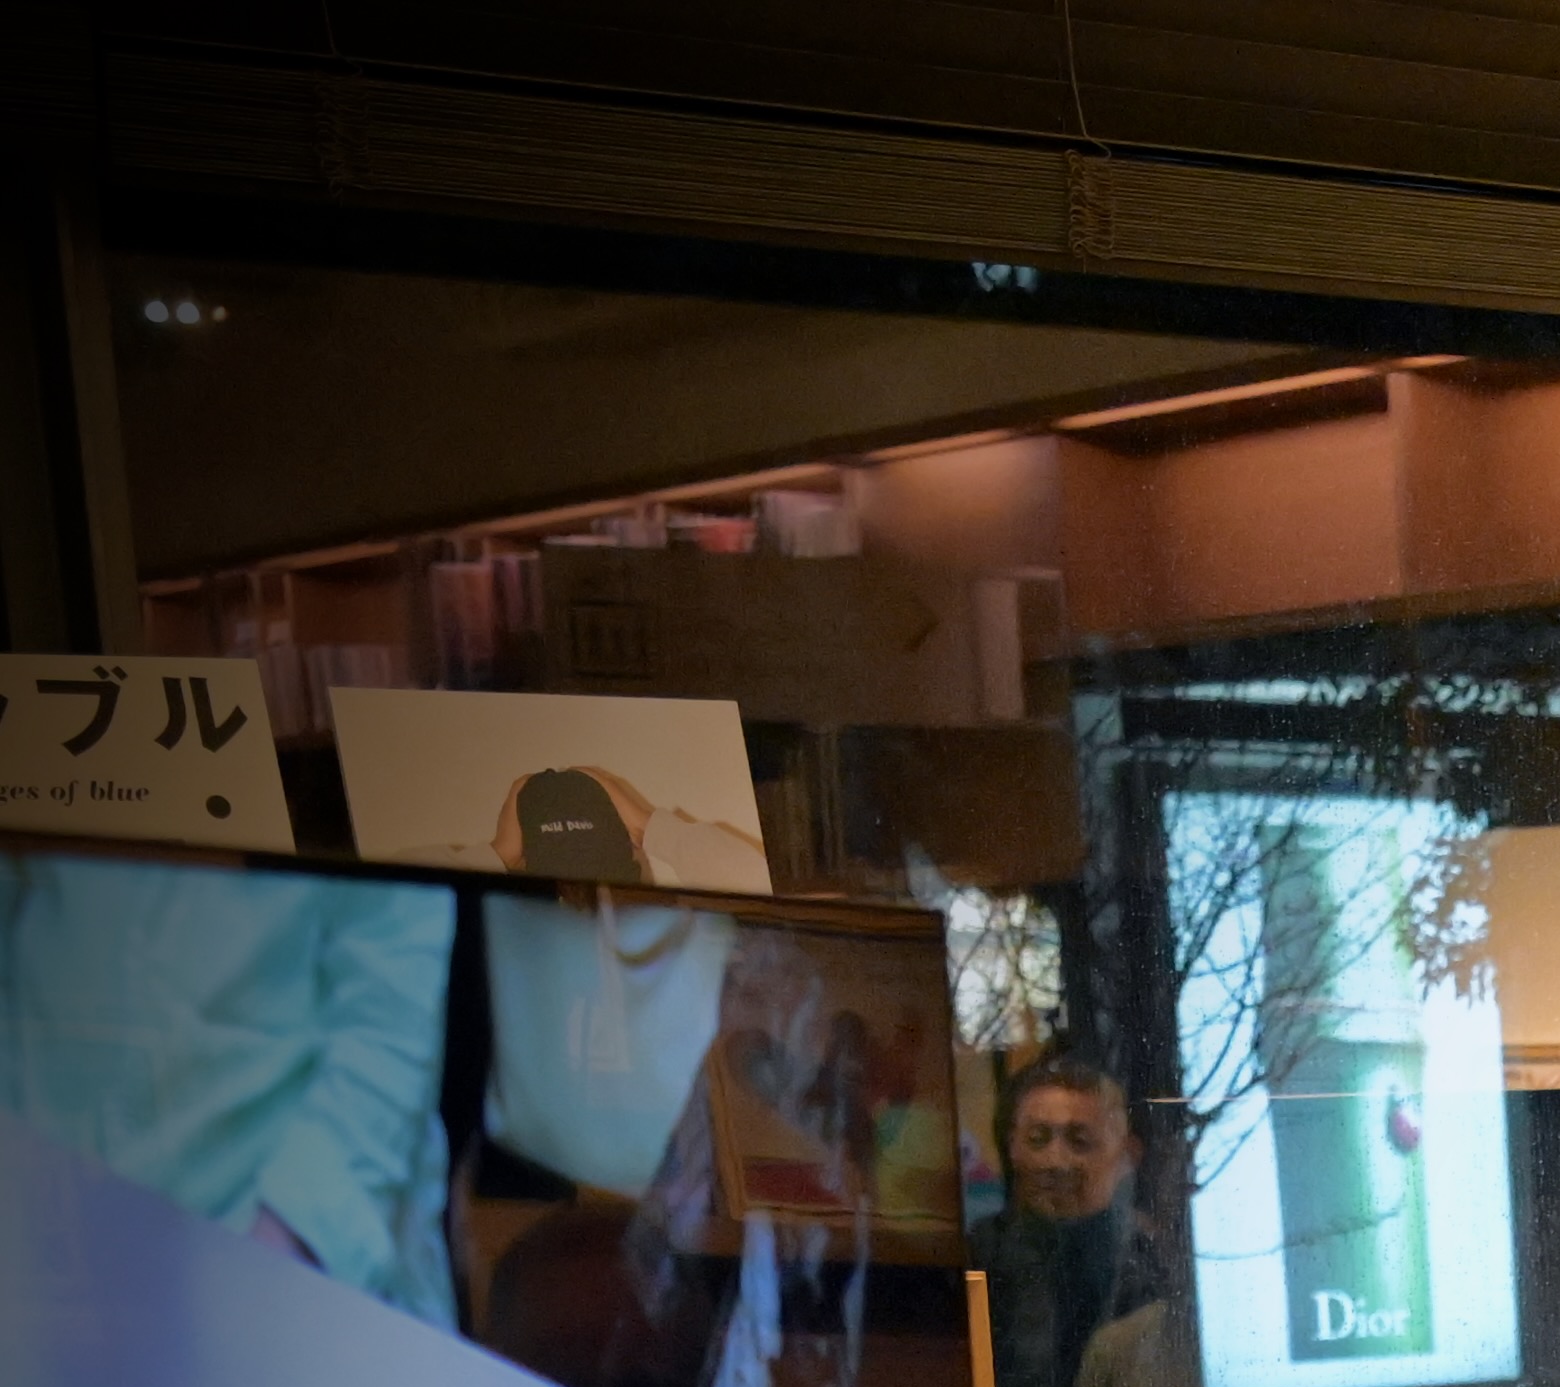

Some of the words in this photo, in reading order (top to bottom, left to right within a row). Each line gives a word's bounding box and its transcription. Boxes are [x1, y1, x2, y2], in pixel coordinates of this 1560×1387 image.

[0, 665, 248, 757] ブル
[51, 780, 78, 806] of
[90, 781, 150, 801] blue
[1311, 1290, 1411, 1341] Dior
